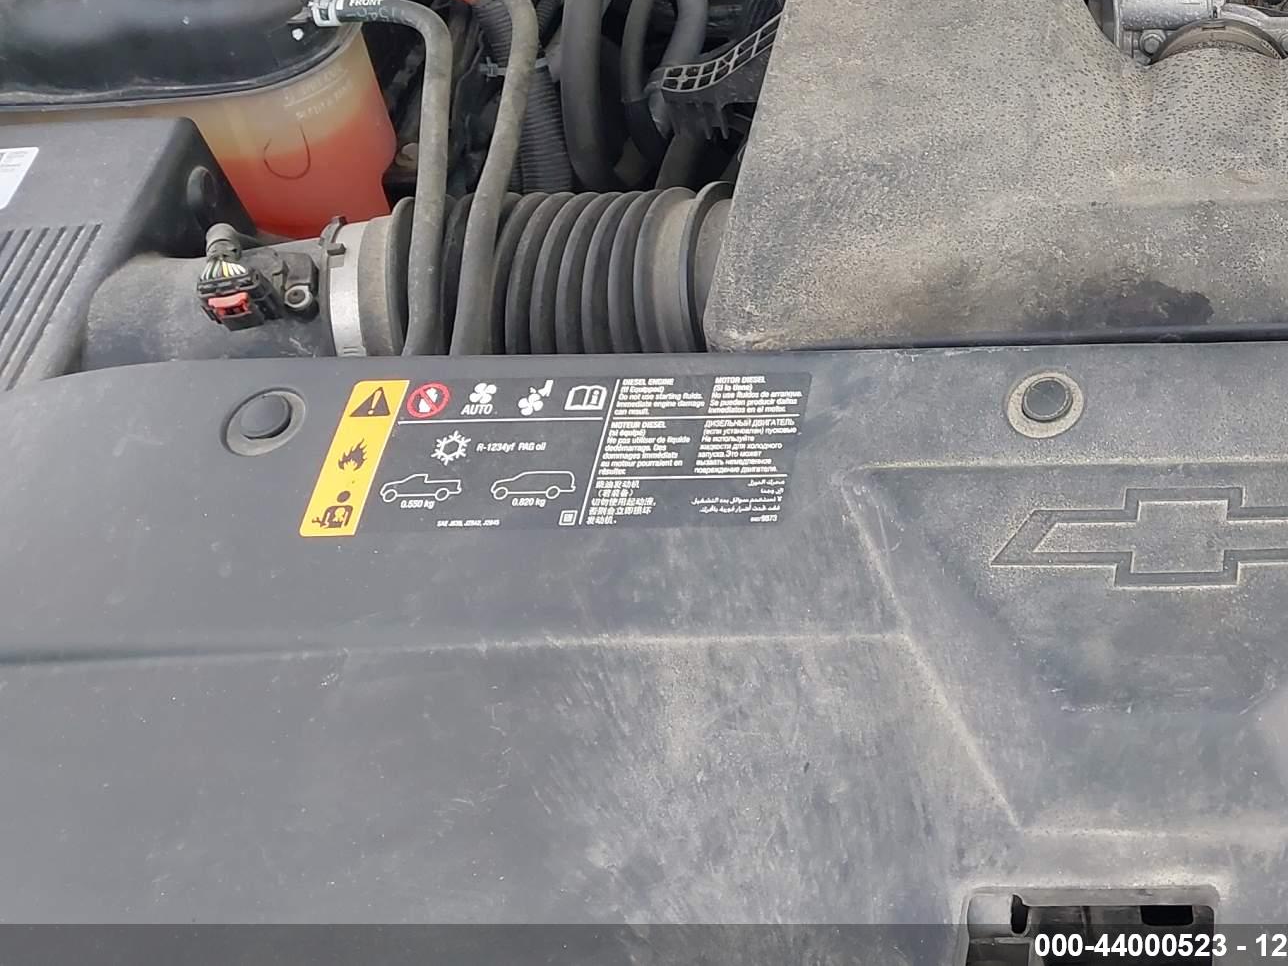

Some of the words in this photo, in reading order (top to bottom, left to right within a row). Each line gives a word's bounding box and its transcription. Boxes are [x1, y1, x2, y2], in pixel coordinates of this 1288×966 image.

[460, 404, 493, 415] AUTO
[476, 443, 516, 452] R-1234yf
[424, 500, 435, 509] kg
[512, 498, 534, 506] 0.820
[535, 498, 546, 507] kg
